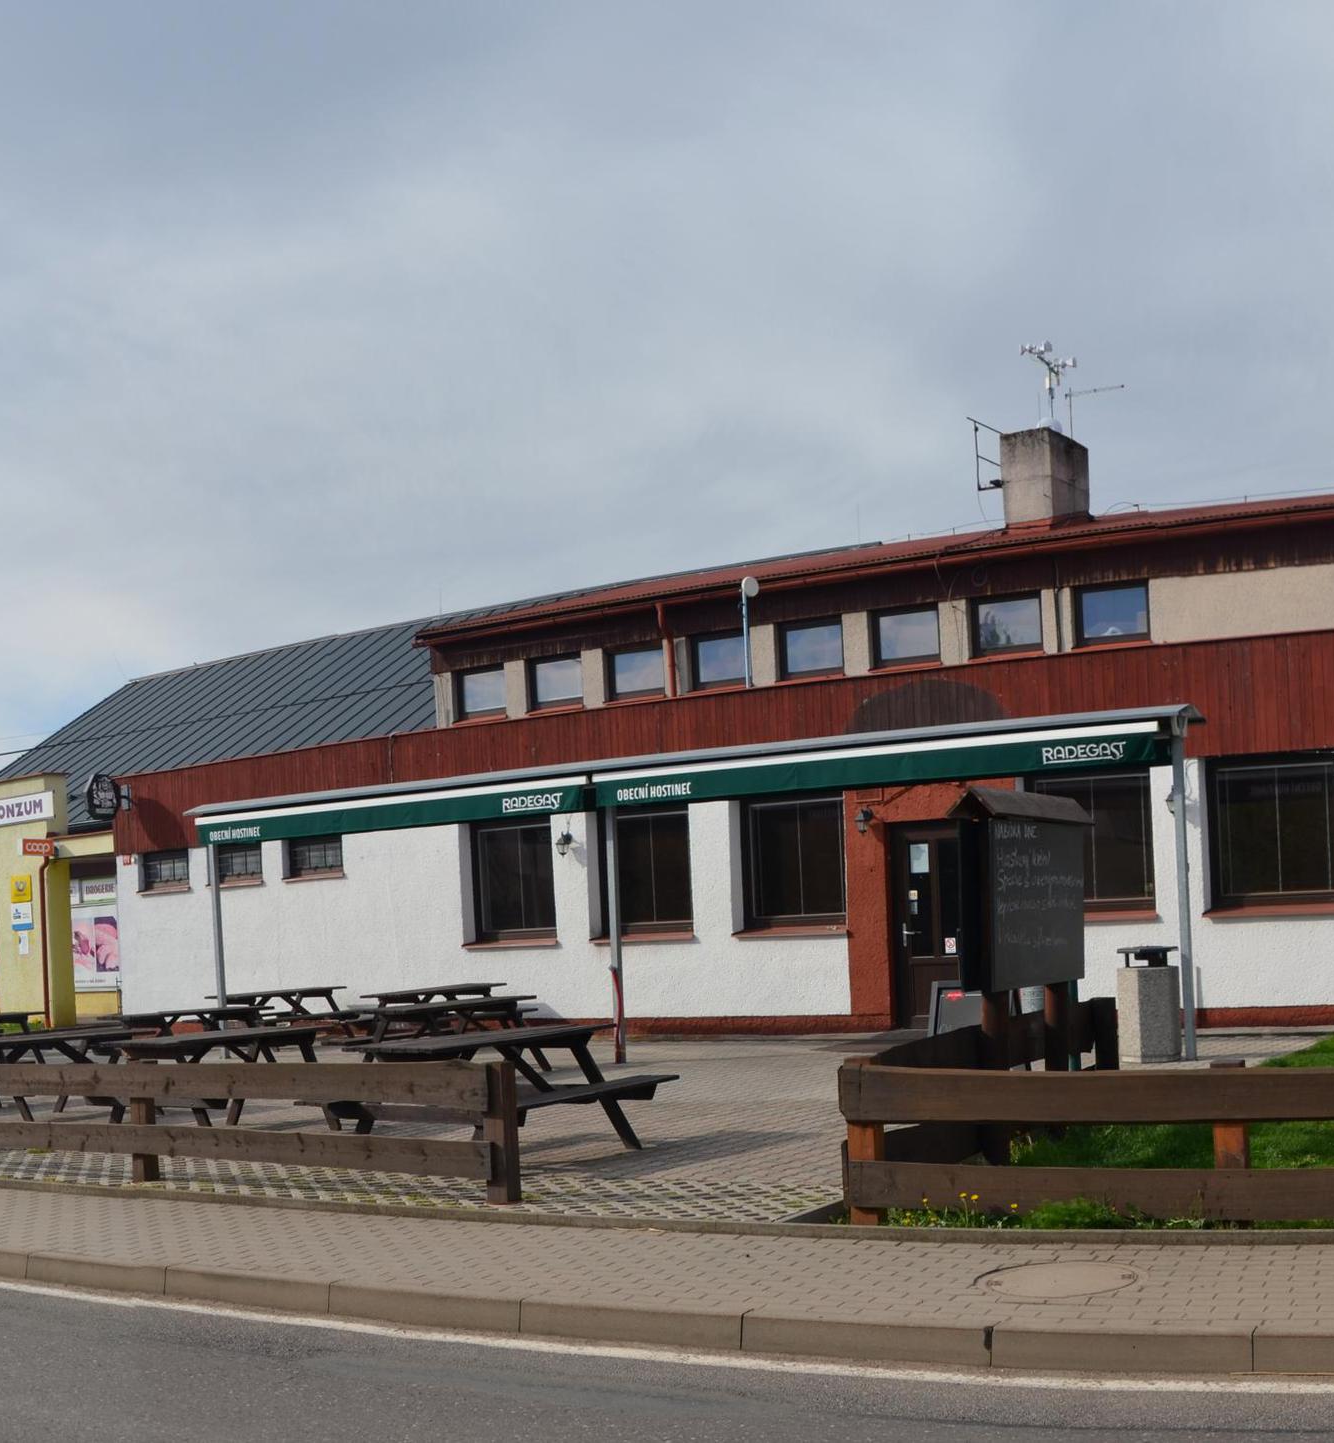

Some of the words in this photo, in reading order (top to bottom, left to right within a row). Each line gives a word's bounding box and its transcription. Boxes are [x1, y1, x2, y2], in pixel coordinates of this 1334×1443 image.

[1042, 741, 1126, 765] RADEGAST
[617, 783, 649, 801] OBECNÍ
[649, 782, 692, 798] HOSTINEC
[502, 792, 563, 813] RADEGAST
[209, 826, 231, 841] OBECNÍ
[231, 826, 261, 839] HOSTINEC
[25, 842, 51, 854] coop
